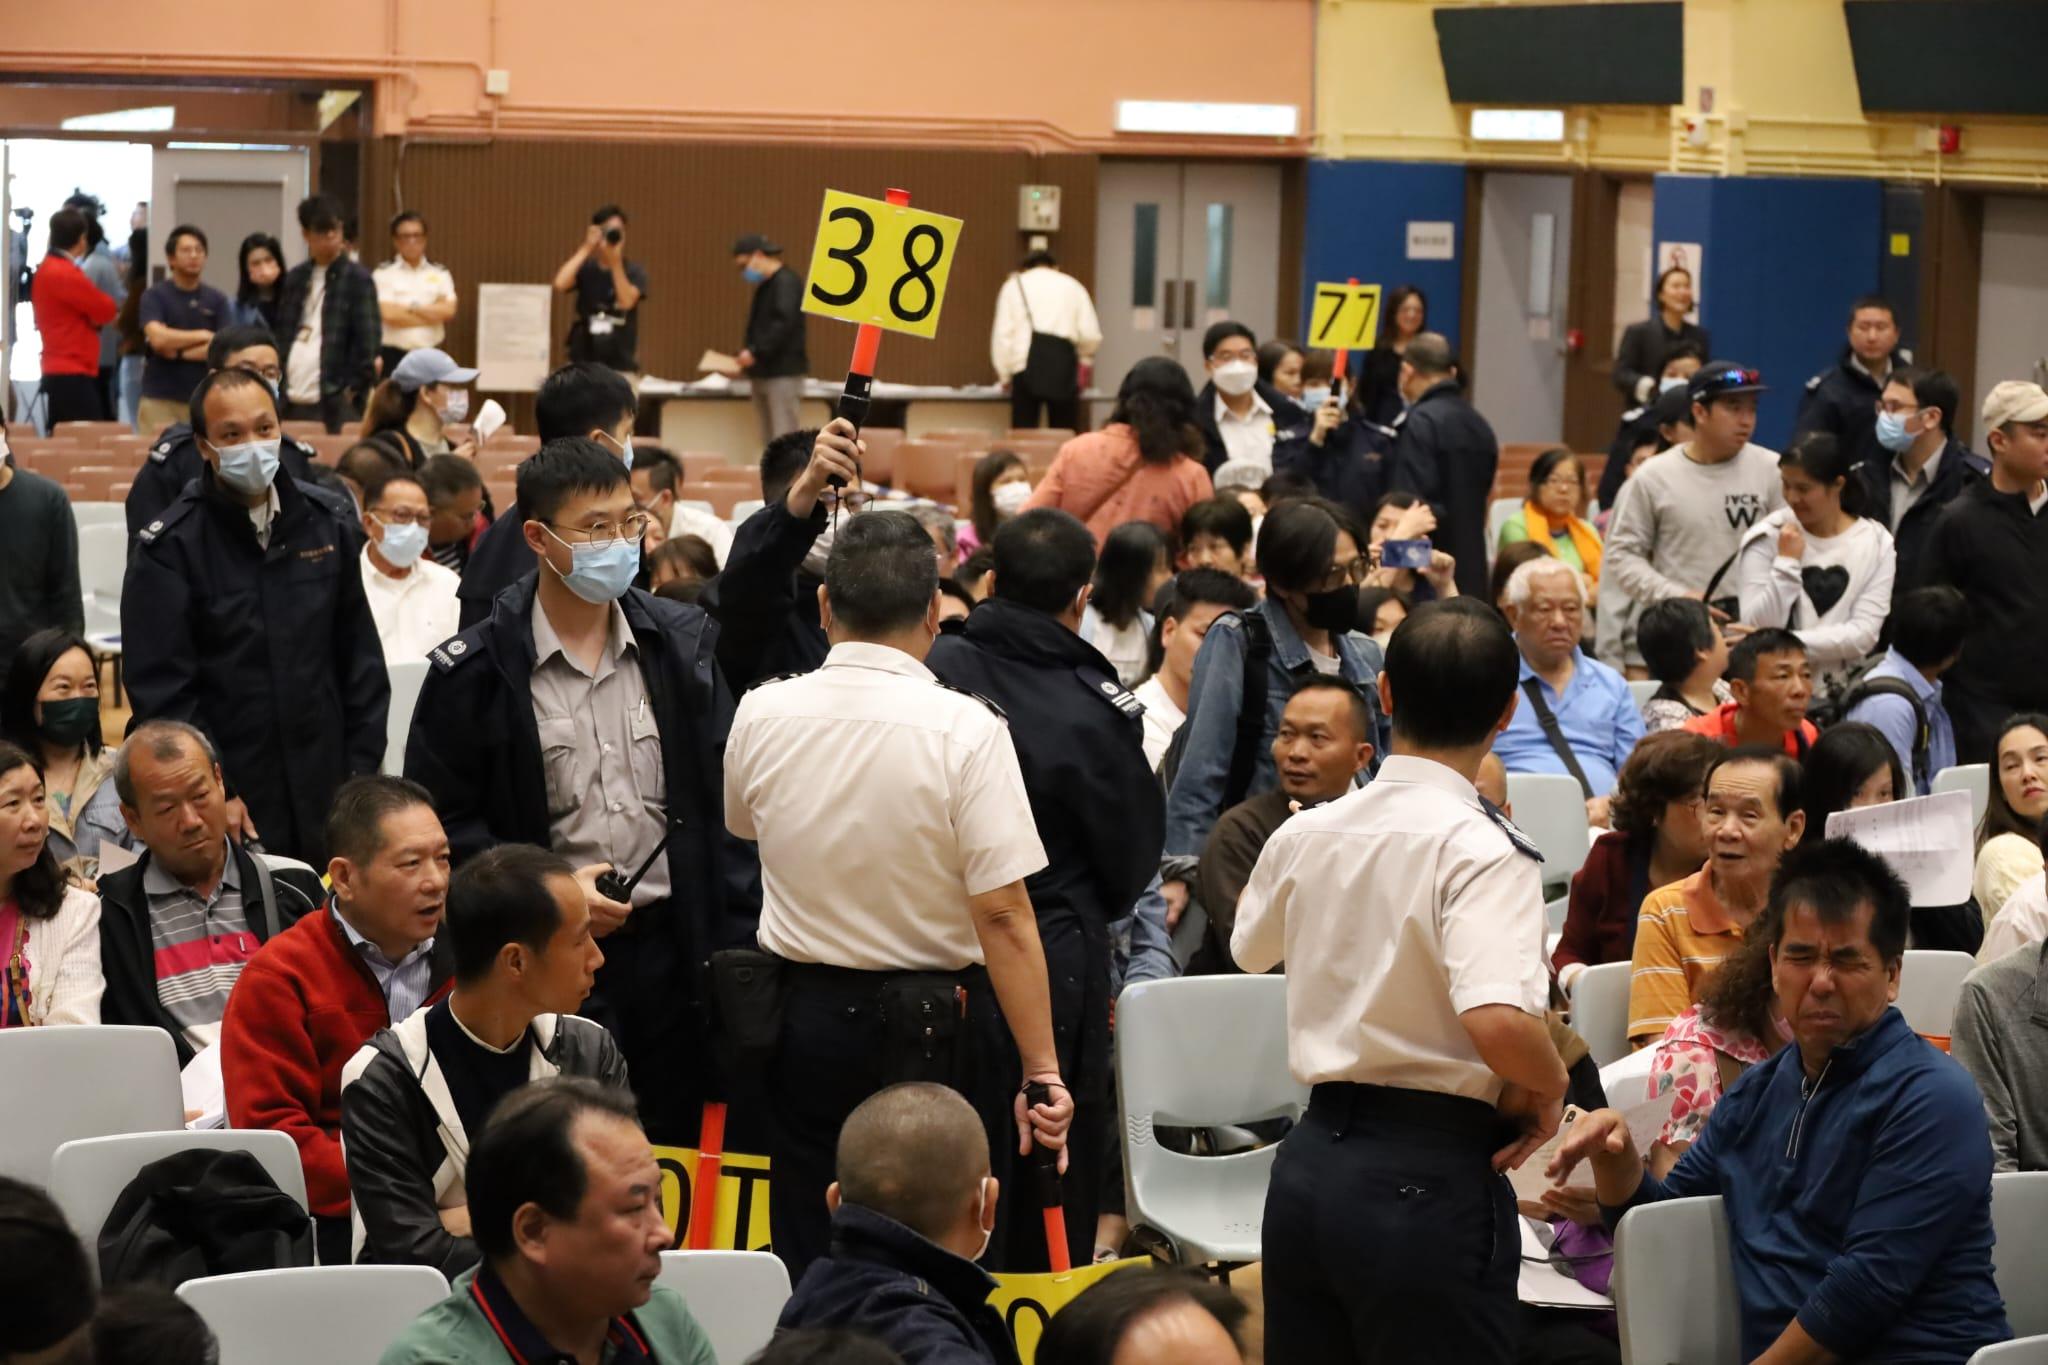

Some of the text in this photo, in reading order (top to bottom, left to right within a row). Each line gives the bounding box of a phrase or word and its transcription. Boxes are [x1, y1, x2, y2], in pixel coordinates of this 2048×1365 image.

[811, 207, 944, 322] 38
[1319, 291, 1375, 342] 77
[1725, 507, 1759, 528] W
